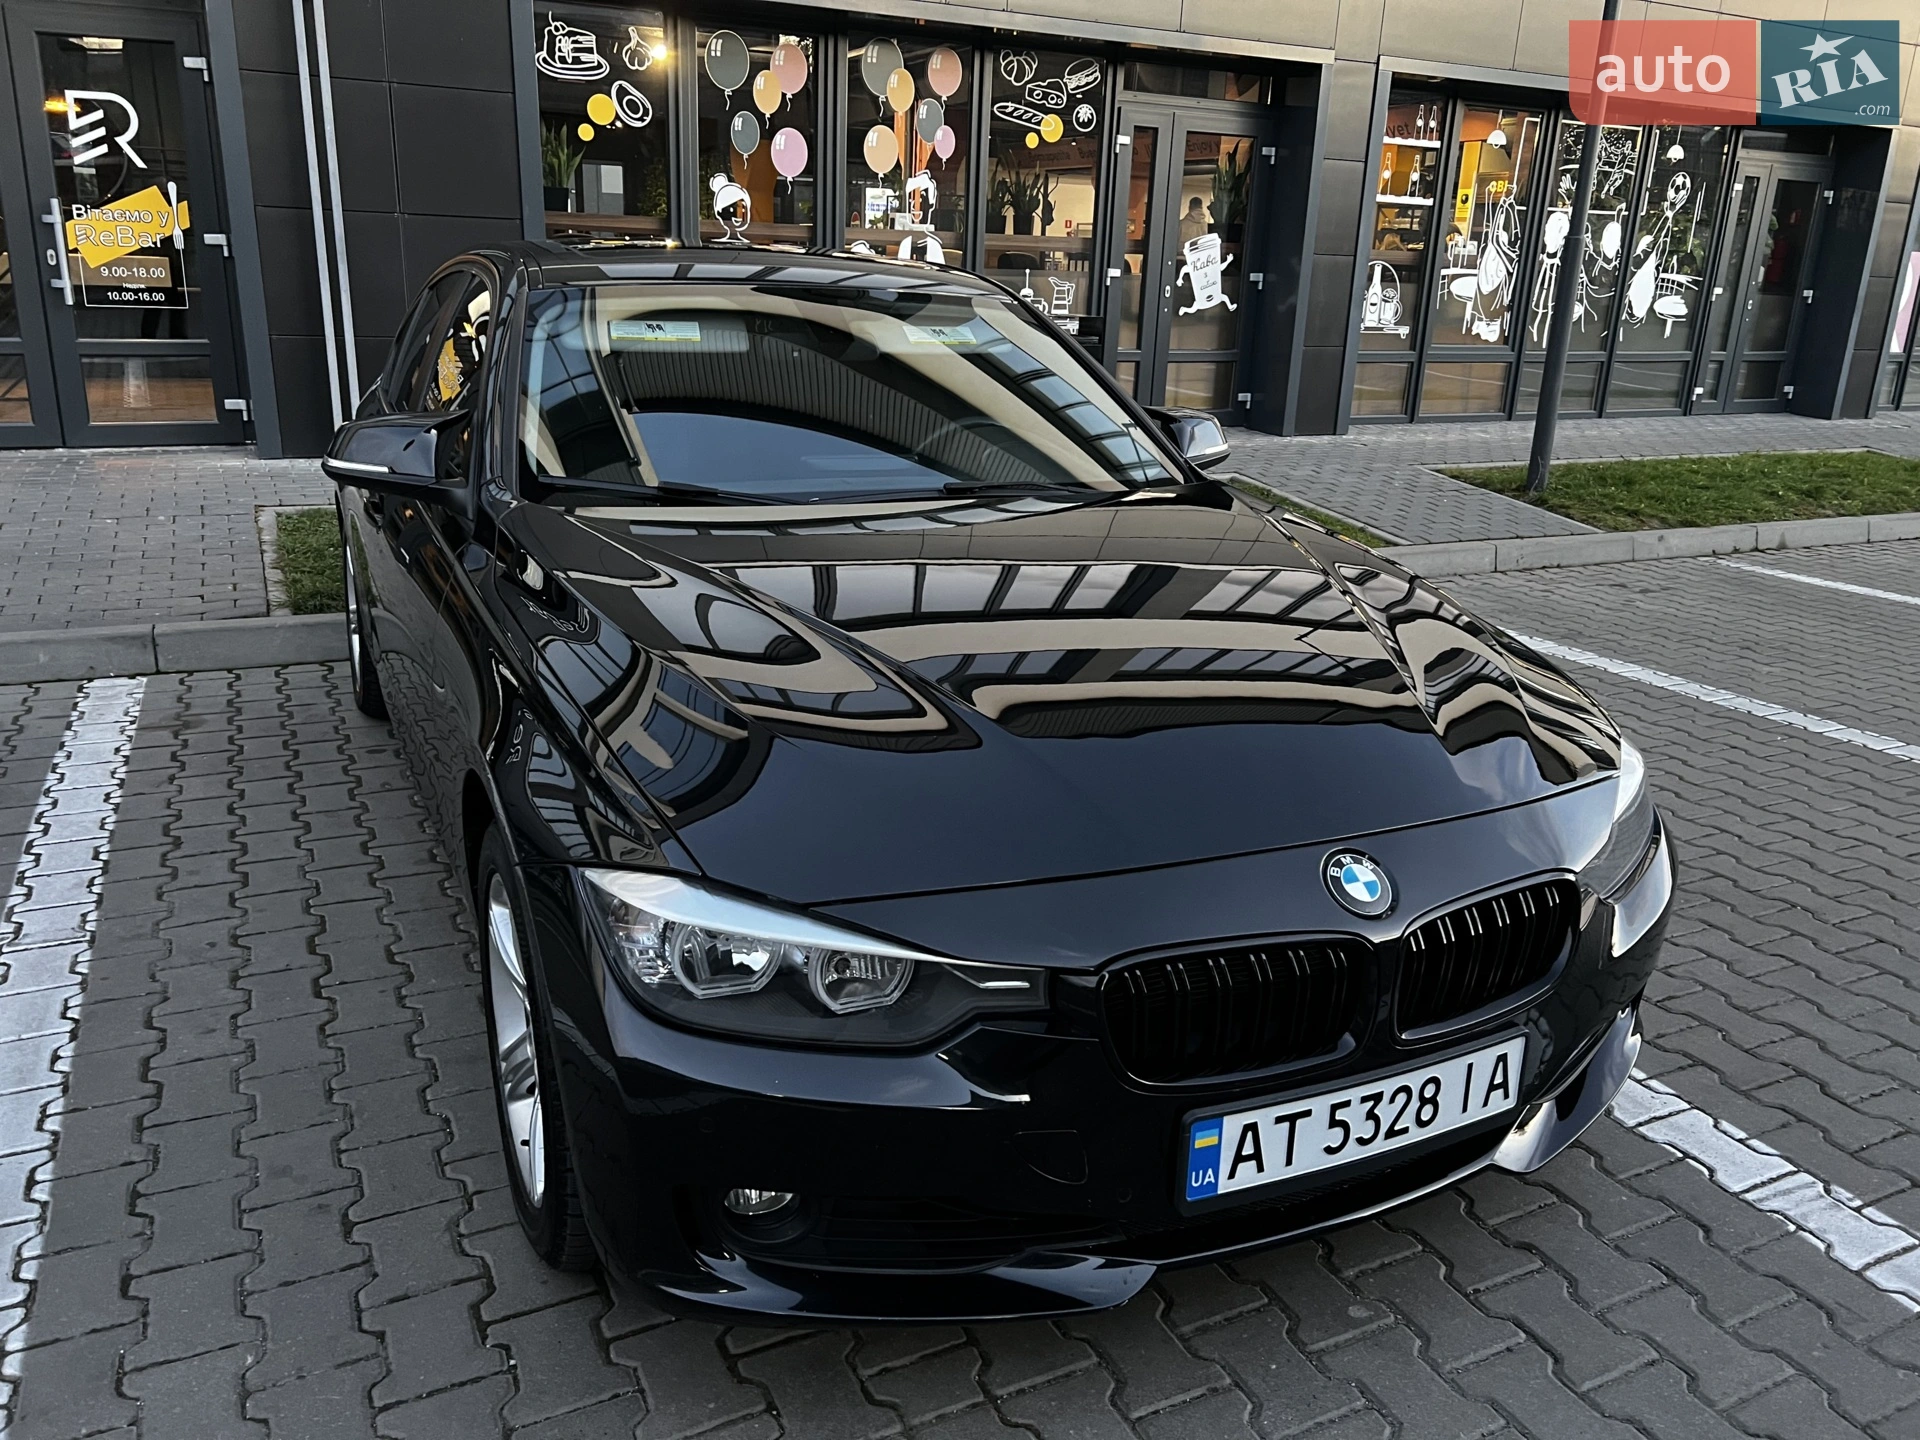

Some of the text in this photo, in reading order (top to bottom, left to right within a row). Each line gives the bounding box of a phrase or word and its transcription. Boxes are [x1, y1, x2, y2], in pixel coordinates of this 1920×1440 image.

[72, 204, 153, 223] Вітаємо
[74, 224, 166, 248] ReBar
[100, 266, 165, 278] 9.00-18.00
[107, 291, 165, 301] 10.00-16.00
[1330, 856, 1375, 877] BMW
[1227, 1052, 1510, 1180] AT 5328 IA
[1191, 1170, 1216, 1187] UA
